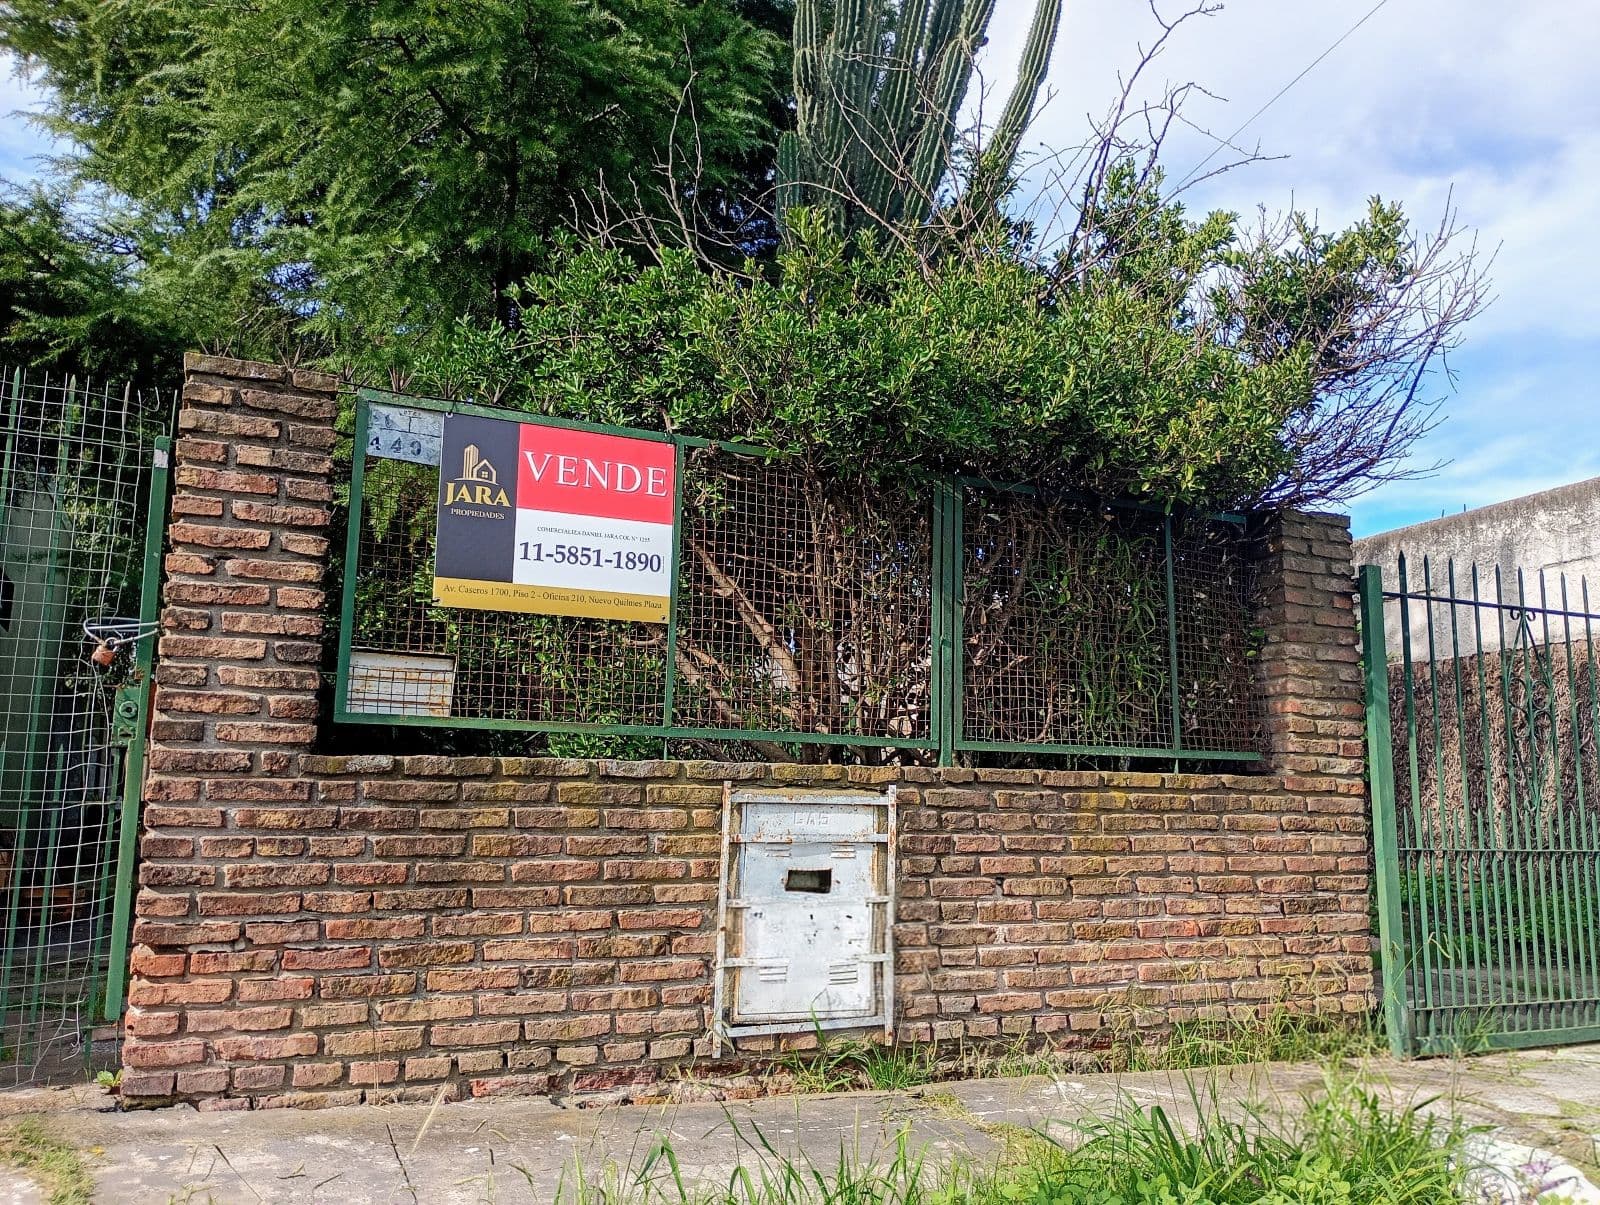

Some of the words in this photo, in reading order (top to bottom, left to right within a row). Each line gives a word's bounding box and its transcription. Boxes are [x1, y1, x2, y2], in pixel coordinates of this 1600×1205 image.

[522, 450, 669, 497] VENDE
[443, 482, 512, 507] JARA
[451, 508, 505, 520] PROPIEDADES
[582, 530, 603, 538] DANIEL
[519, 541, 662, 573] 11-5851-1890
[443, 585, 456, 593] Av.
[458, 585, 488, 595] Caseros
[491, 587, 511, 597] 1700,
[513, 589, 529, 598] Piso
[531, 590, 536, 599] 2
[543, 591, 570, 602] Oficina
[571, 594, 587, 604] 210,
[588, 596, 612, 605] Nuevo
[613, 598, 643, 607] Quilmes
[644, 600, 662, 609] Plaza
